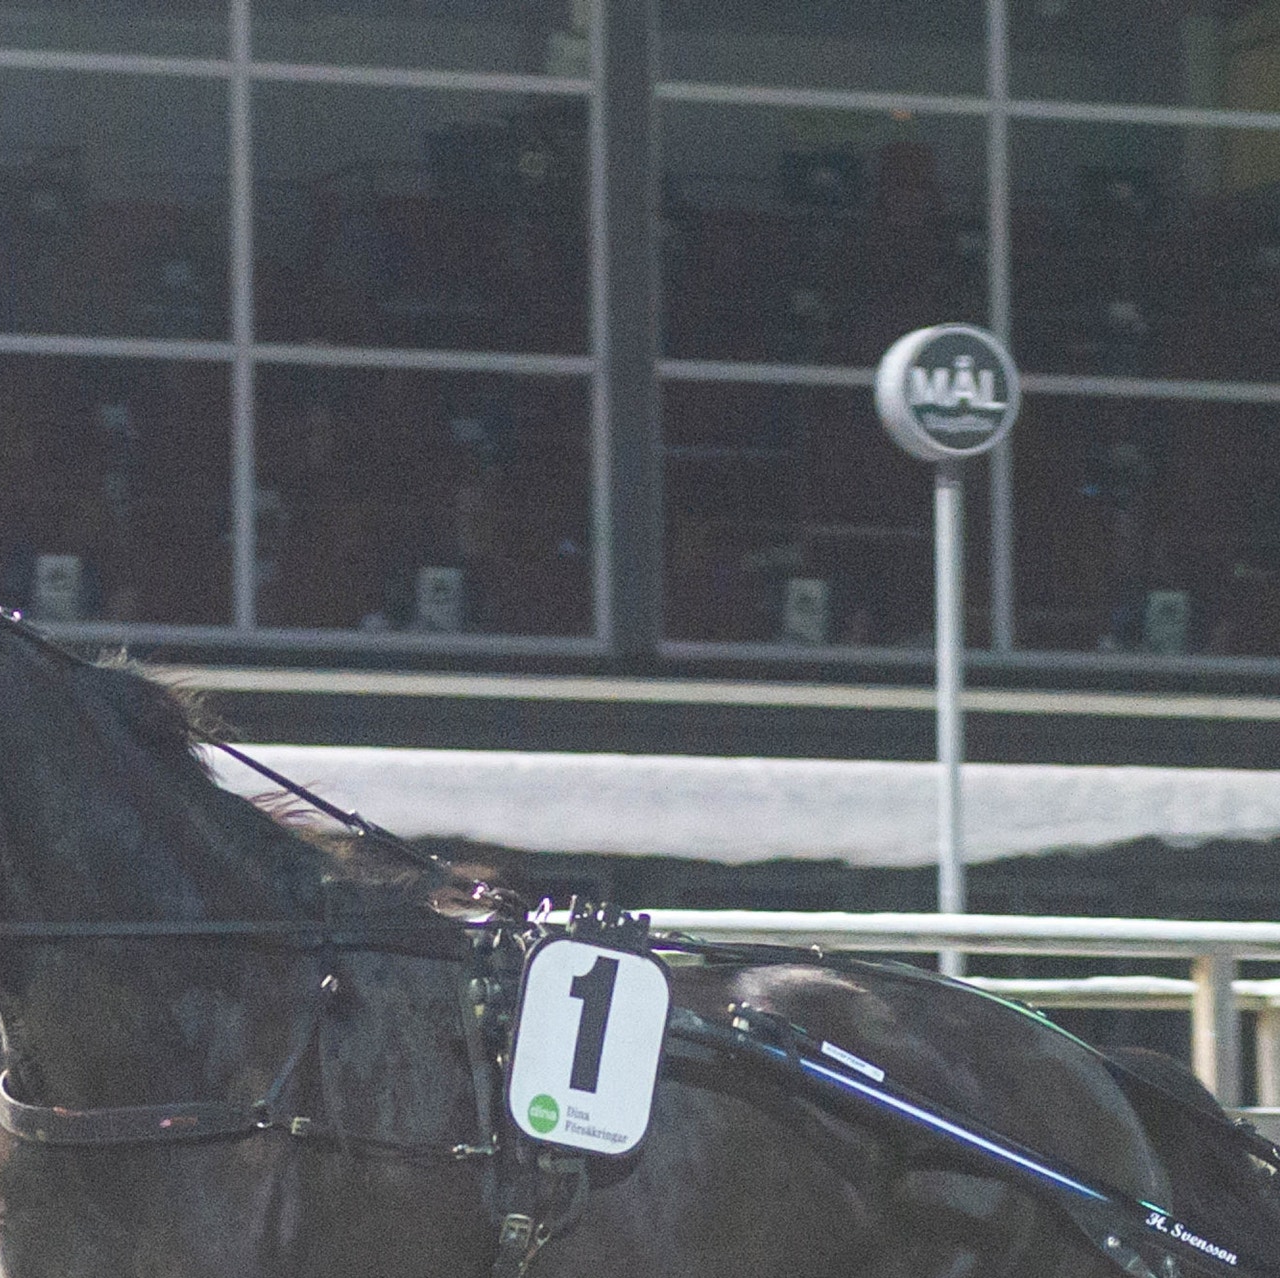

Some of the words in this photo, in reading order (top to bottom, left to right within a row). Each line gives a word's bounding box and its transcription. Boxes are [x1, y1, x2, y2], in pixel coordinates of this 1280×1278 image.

[909, 355, 1007, 409] MÅL
[569, 955, 620, 1094] 1
[1170, 1222, 1238, 1266] Svensson
